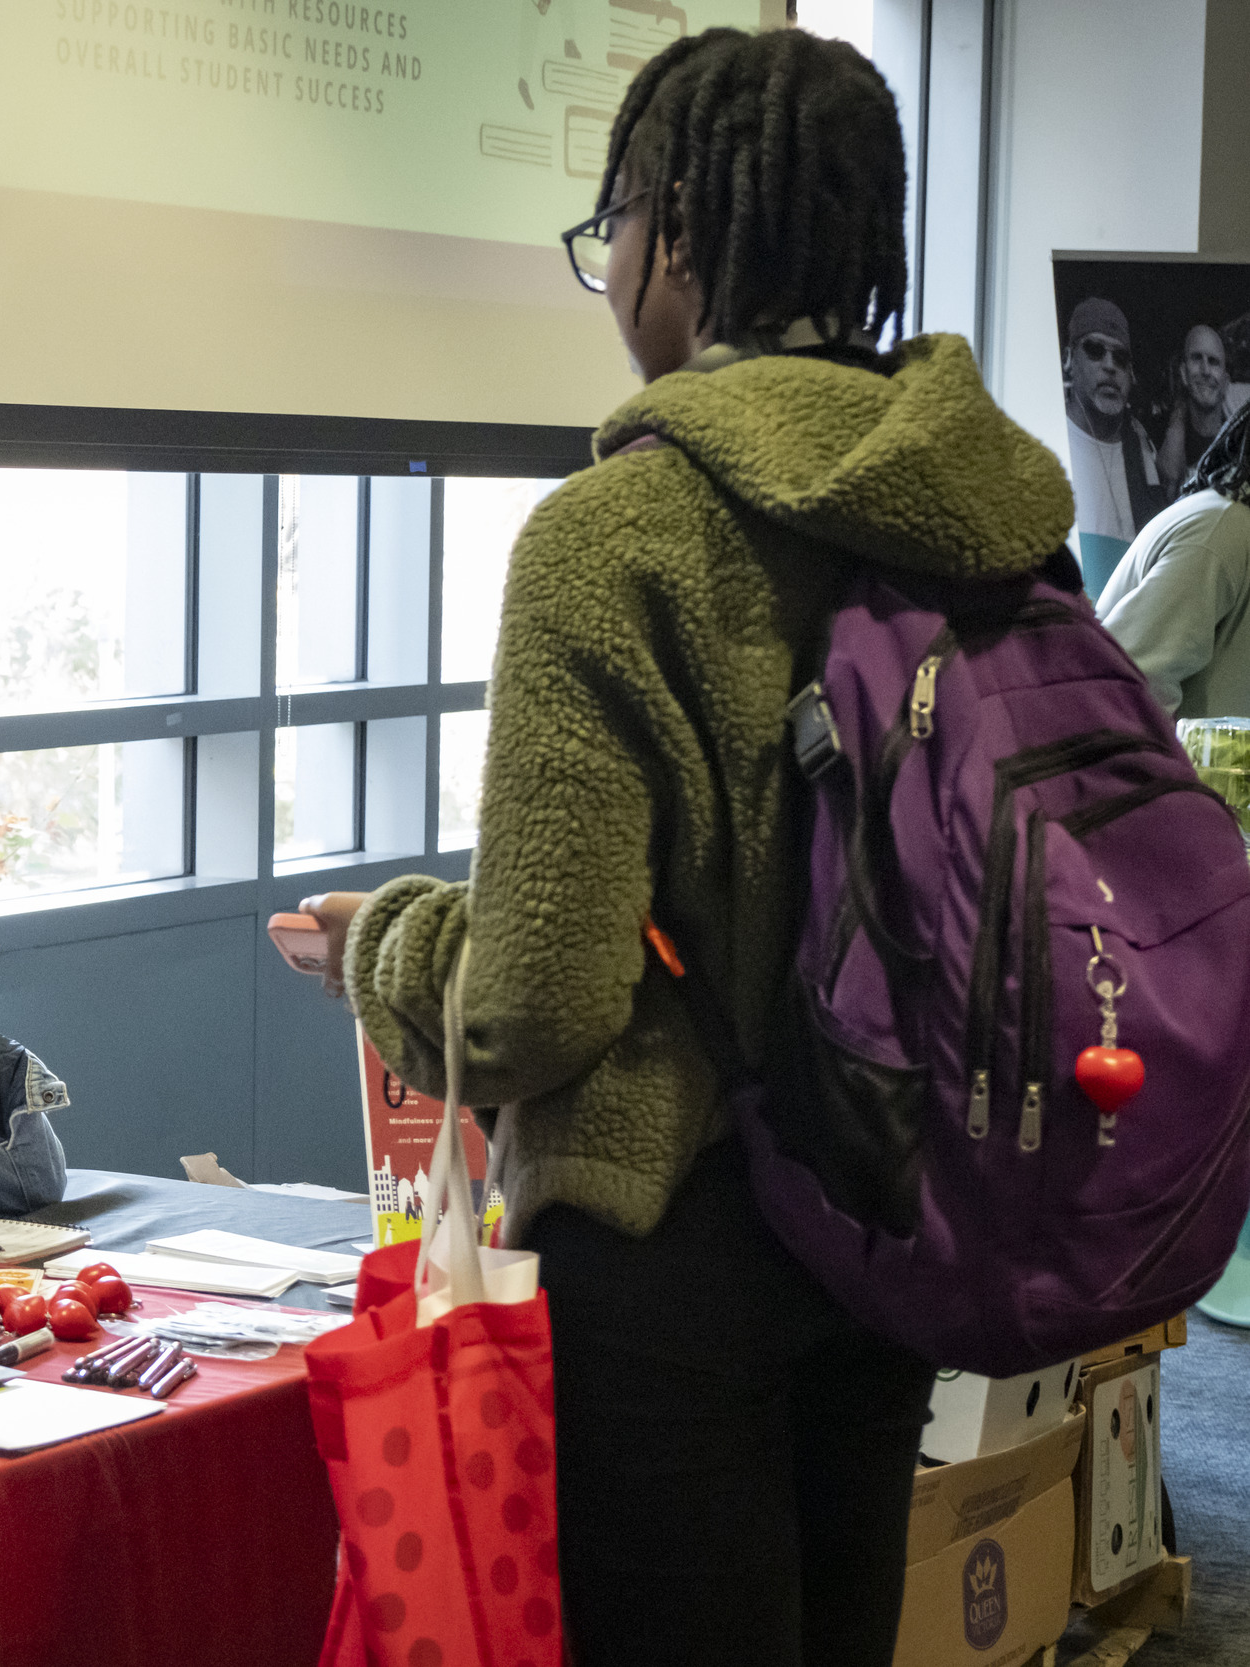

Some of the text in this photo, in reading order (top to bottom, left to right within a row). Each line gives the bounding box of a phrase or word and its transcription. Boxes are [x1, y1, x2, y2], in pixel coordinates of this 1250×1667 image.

[55, 0, 423, 82] SUPPORTING BASIC NEEDS AND
[288, 0, 407, 40] RESOURCES
[55, 36, 385, 115] OVERALL STUDENT SUCCESS
[388, 1117, 434, 1125] Mindfulness
